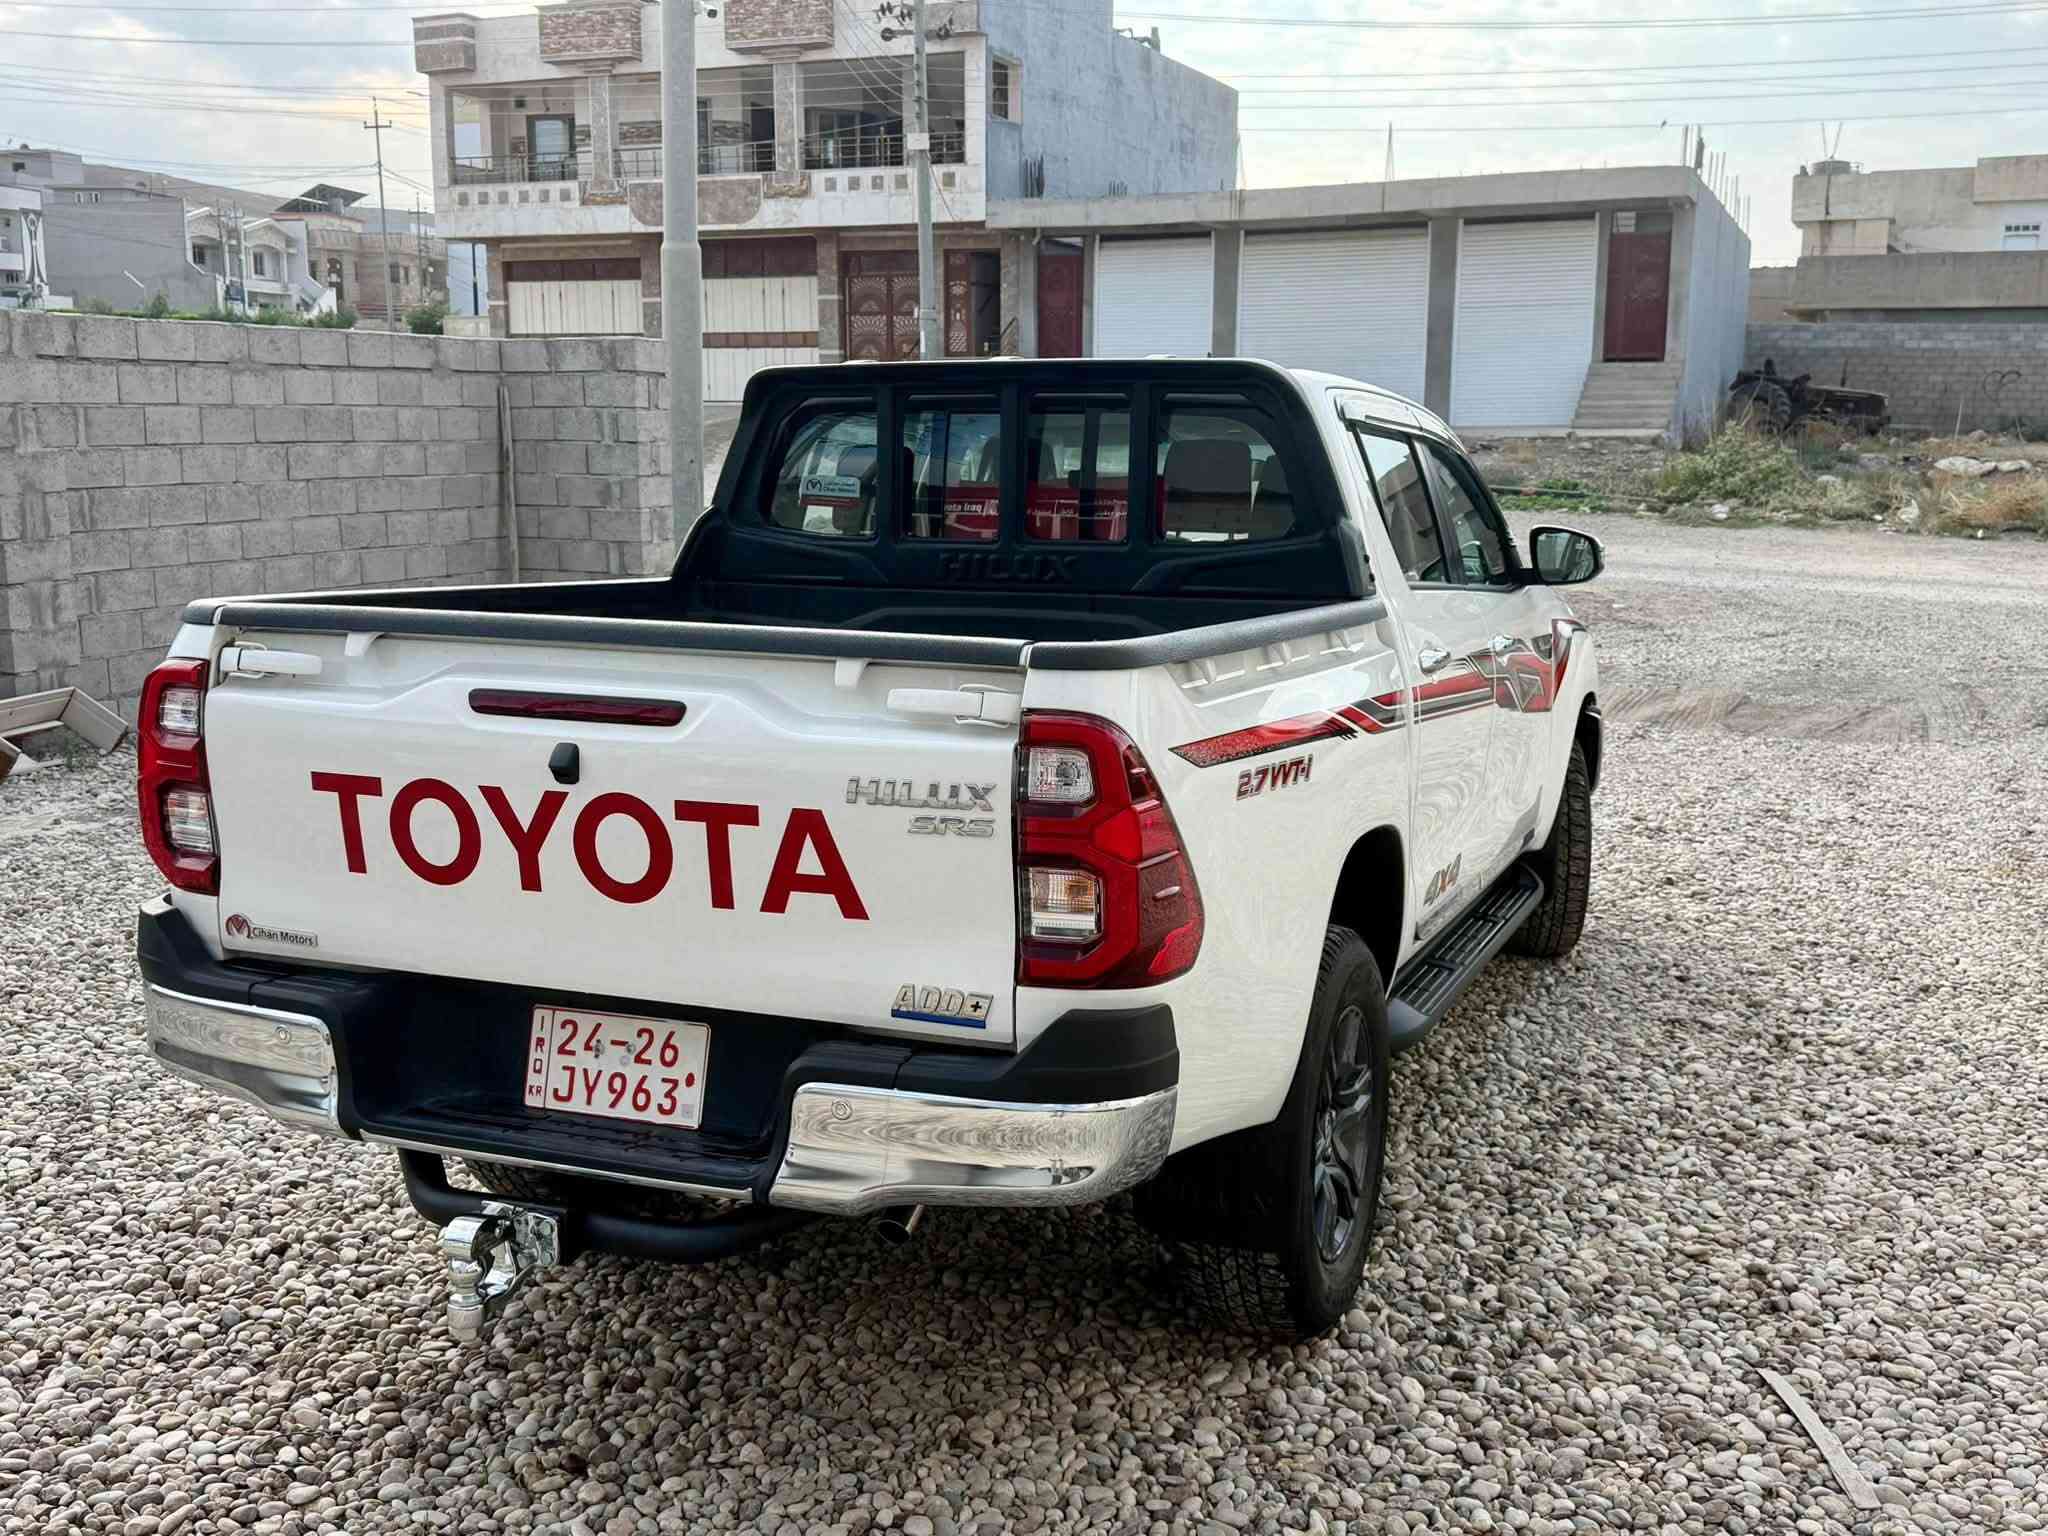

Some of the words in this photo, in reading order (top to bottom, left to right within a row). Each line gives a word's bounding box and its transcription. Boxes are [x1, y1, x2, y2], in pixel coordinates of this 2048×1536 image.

[939, 551, 1078, 585] HILUX
[846, 776, 997, 812] HILUX
[908, 815, 995, 838] SRS
[311, 771, 870, 921] TOYOTA
[252, 926, 279, 940] Cihan
[280, 931, 314, 947] Motors
[533, 1015, 546, 1075] IRQ
[557, 1018, 680, 1068] 24-26
[528, 1084, 542, 1097] KR
[552, 1065, 680, 1116] JY963
